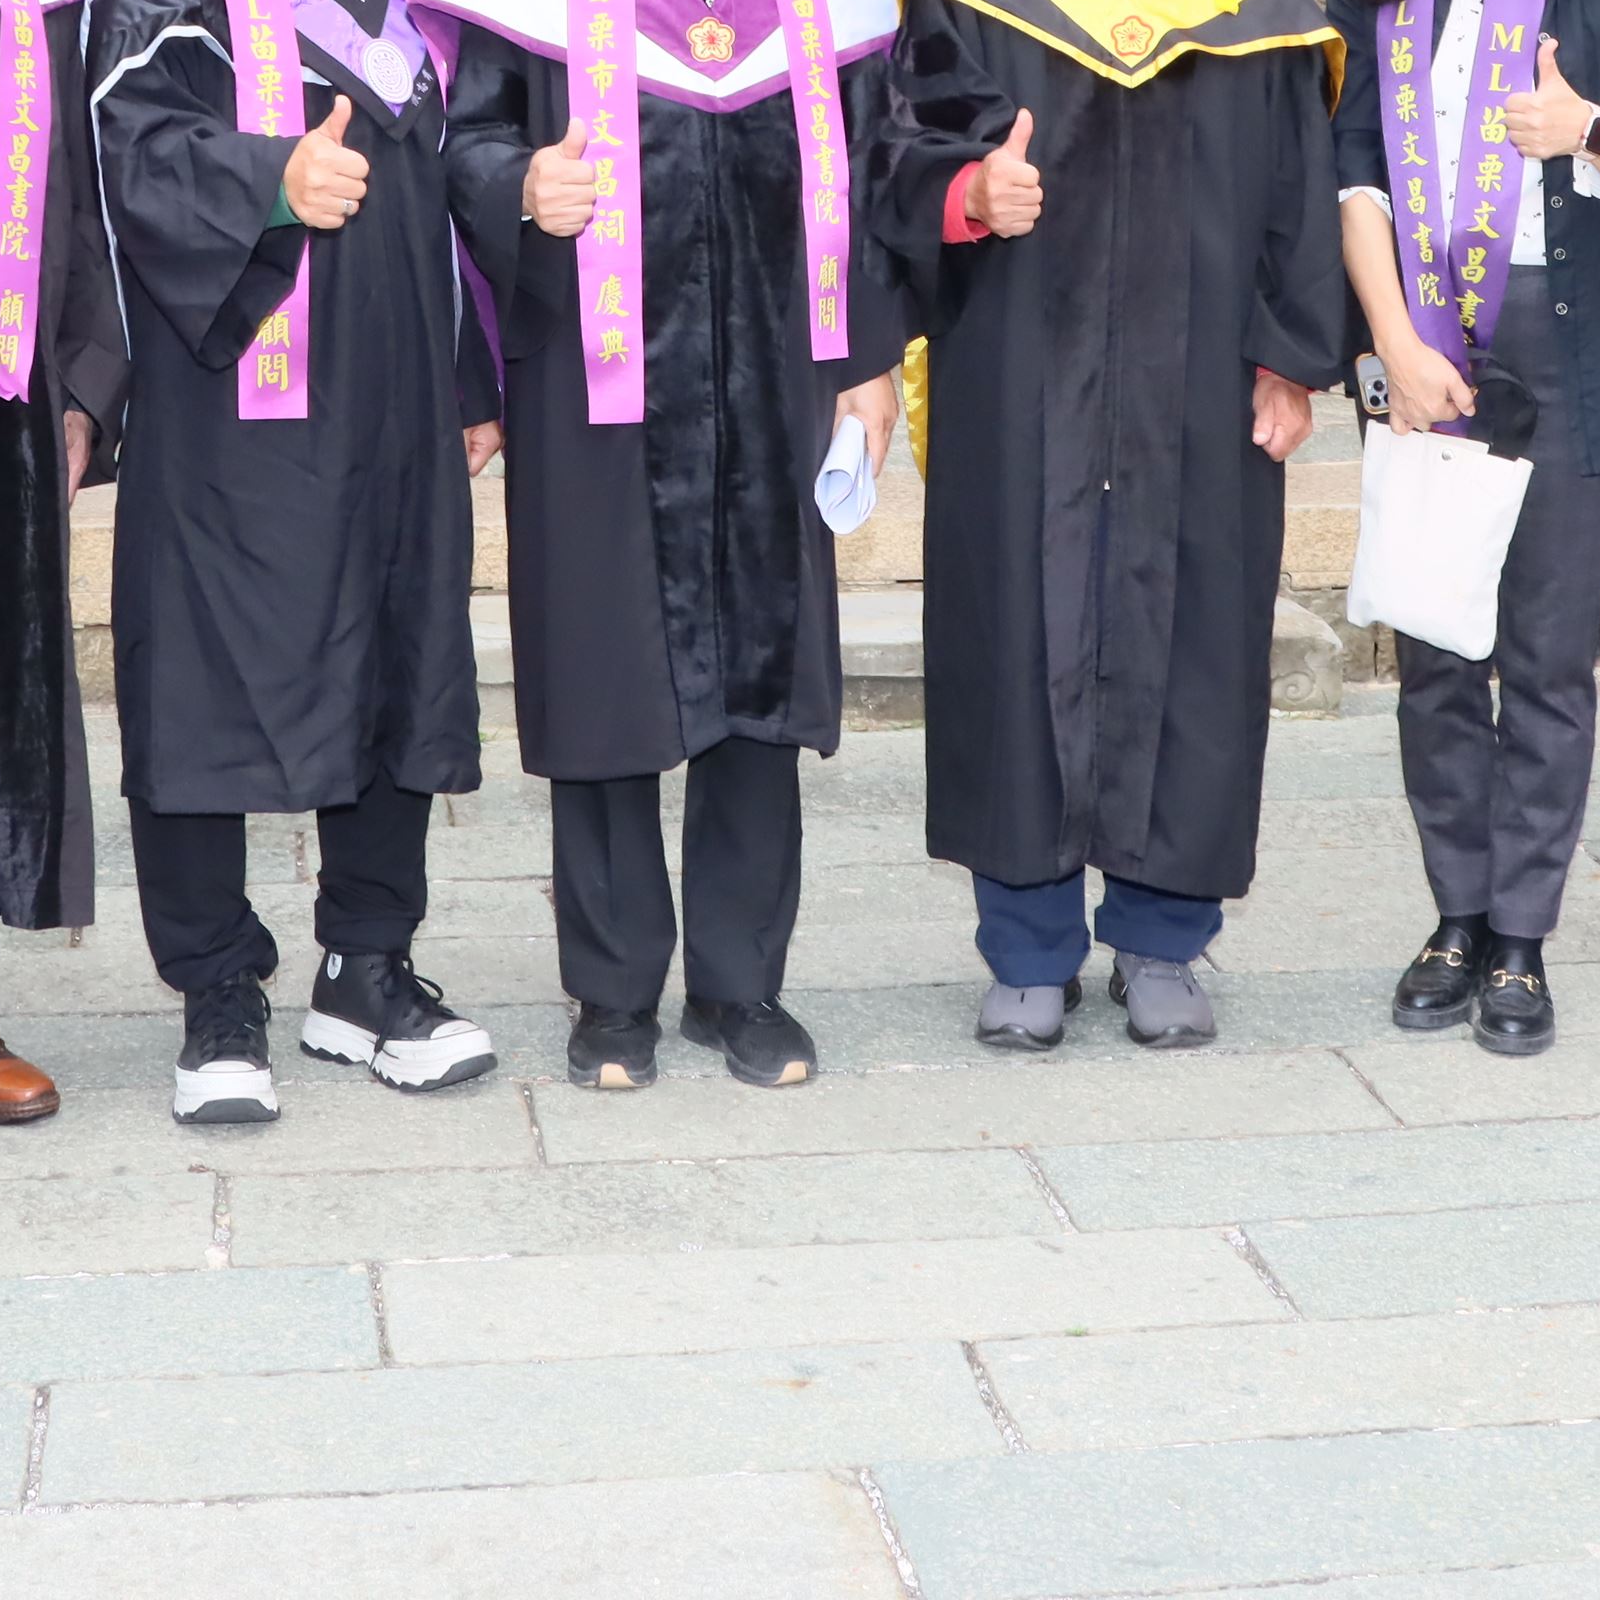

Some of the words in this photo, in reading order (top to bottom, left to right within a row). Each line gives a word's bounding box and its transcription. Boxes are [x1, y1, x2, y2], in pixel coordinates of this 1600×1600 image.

[1455, 21, 1525, 345] ML苗栗文昌書
[592, 273, 631, 365] 慶典
[816, 253, 840, 334] 顧問
[255, 309, 291, 392] 顧問
